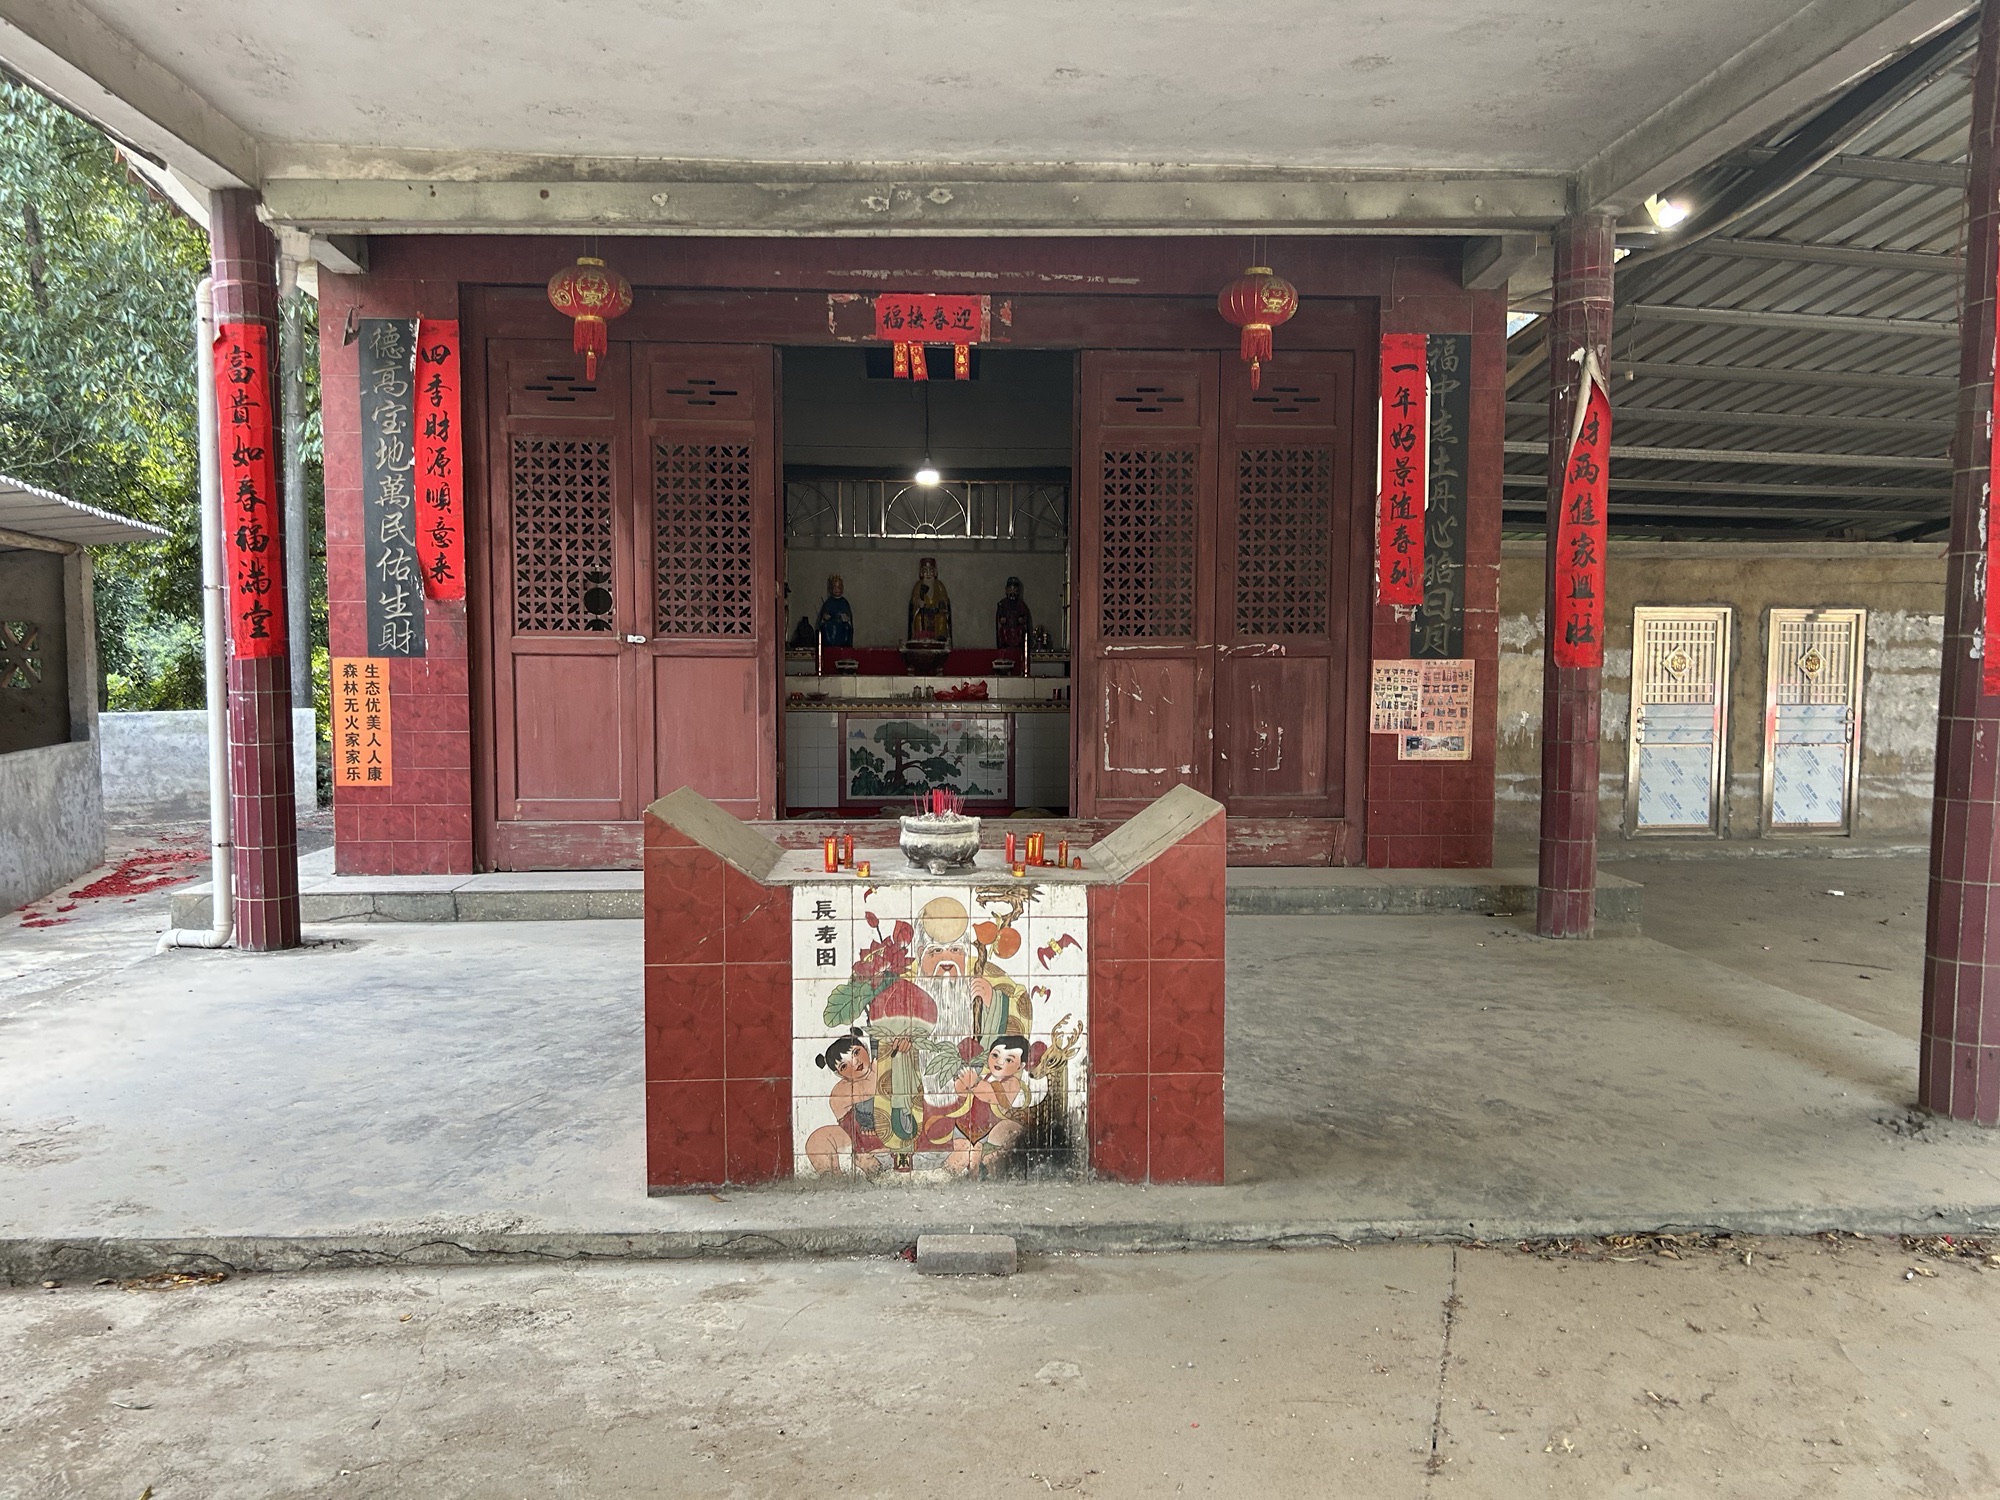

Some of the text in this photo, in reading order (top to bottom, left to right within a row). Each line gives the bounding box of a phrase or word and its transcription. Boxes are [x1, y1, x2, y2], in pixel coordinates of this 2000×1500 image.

[342, 663, 361, 781] 森林无火家家乐
[365, 663, 383, 781] 生态优美人人康
